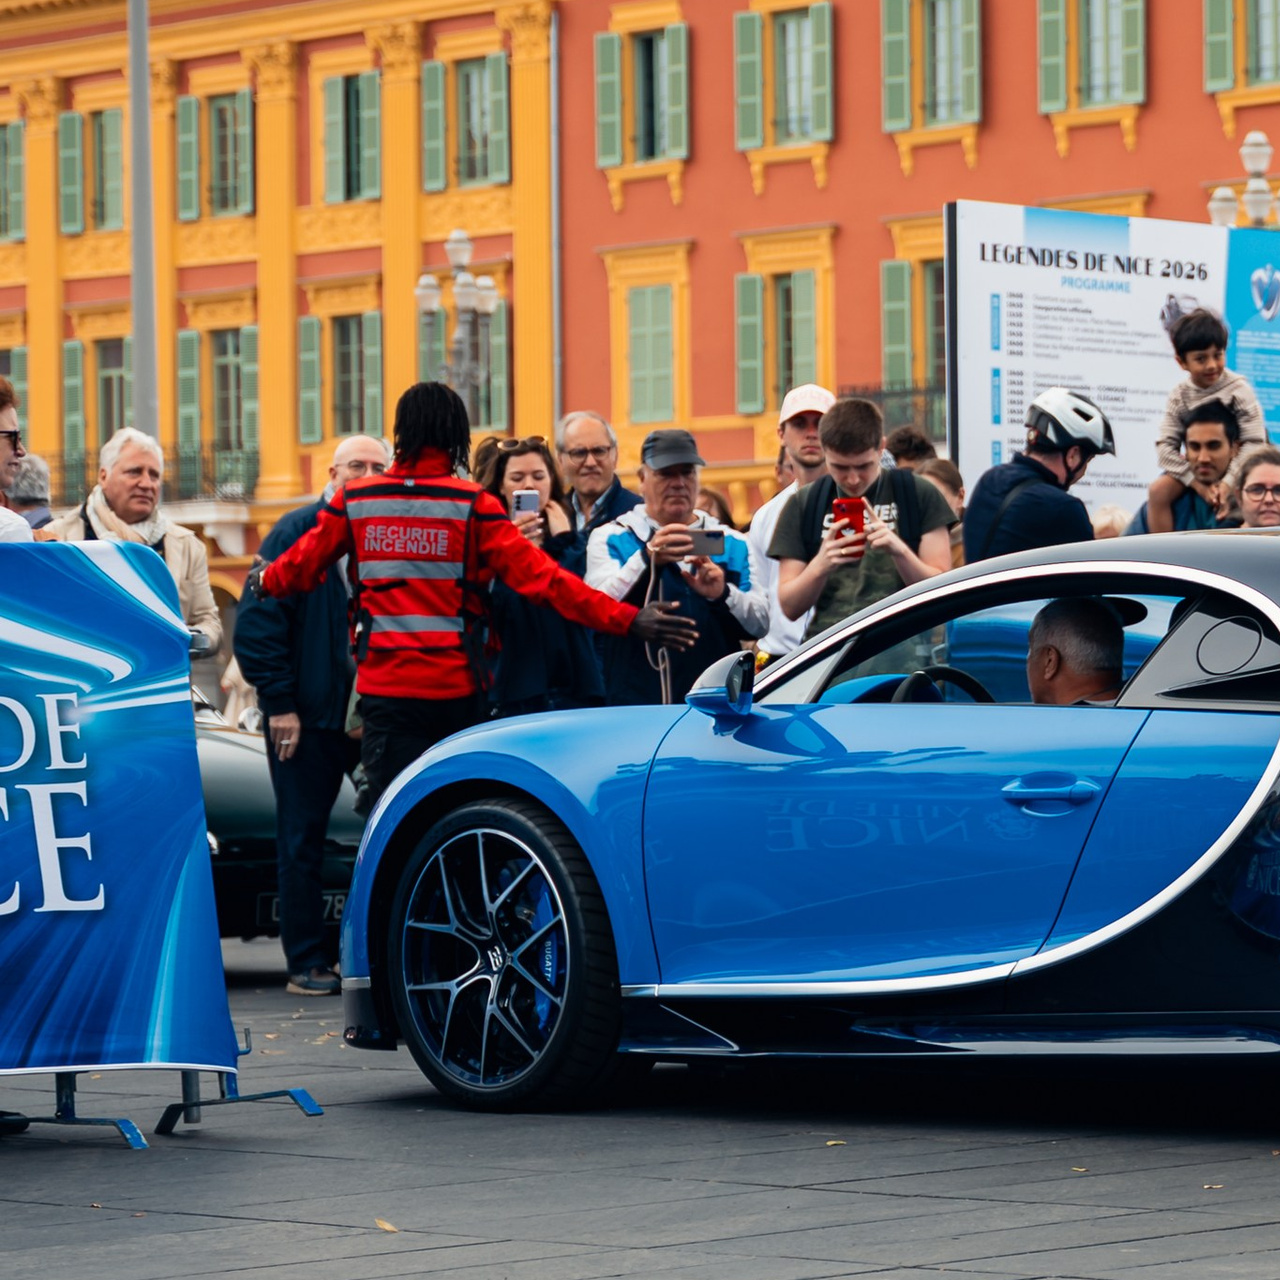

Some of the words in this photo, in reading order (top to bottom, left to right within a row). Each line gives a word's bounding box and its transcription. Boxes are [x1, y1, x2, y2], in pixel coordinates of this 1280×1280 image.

[980, 242, 1078, 270] LEGENDES
[1084, 252, 1107, 273] DE
[1113, 255, 1154, 277] NICE
[1160, 259, 1208, 281] 2026
[1060, 275, 1131, 294] PROGRAMME
[366, 525, 448, 542] SECURITE
[364, 538, 448, 556] INCENDIE
